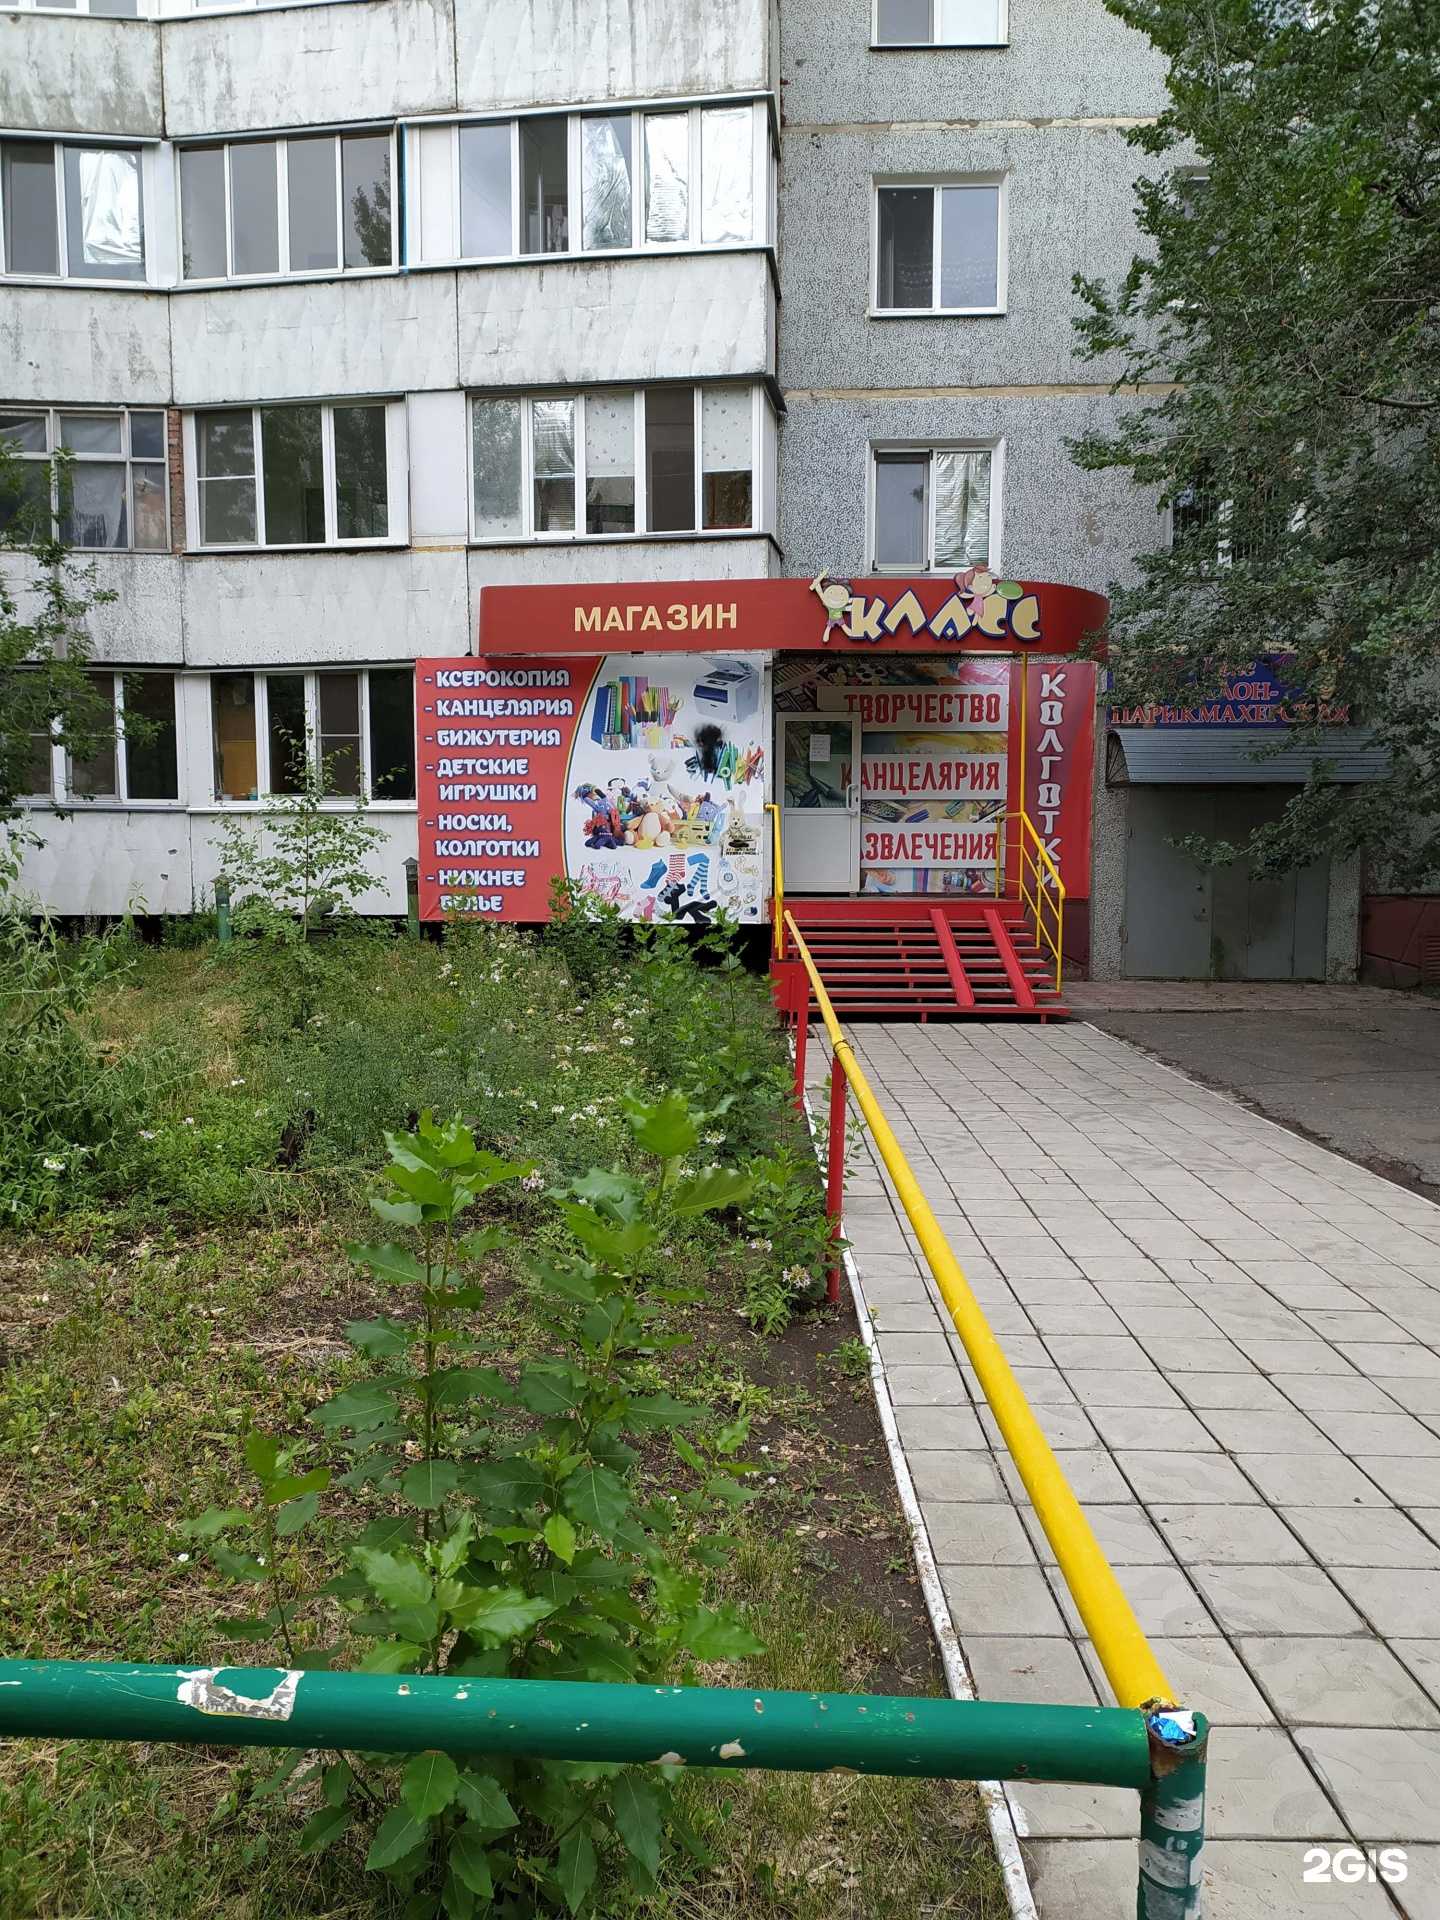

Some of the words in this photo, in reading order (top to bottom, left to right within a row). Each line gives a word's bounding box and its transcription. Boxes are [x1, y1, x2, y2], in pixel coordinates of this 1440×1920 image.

[574, 603, 738, 632] МАГАЗИН
[848, 587, 1042, 641] КЛАСС
[436, 670, 570, 688] КСЕРОКОПИЯ
[436, 699, 573, 719] КАНЦЕЛЯРИЯ
[844, 693, 1001, 724] ТВОРЧЕСТВО
[436, 729, 561, 746] БИЖУТЕРИЯ
[437, 758, 529, 778] ДЕТСКИЕ
[840, 762, 1001, 796] КАНЦЕЛЯРИЯ
[1036, 673, 1067, 889] КОЛГОТКИ
[439, 784, 537, 801] ИГРУШКИ
[438, 814, 513, 833] НОСКИ,
[435, 840, 539, 857] КОЛГОТКИ
[438, 869, 526, 887] НИЖНЕЕ
